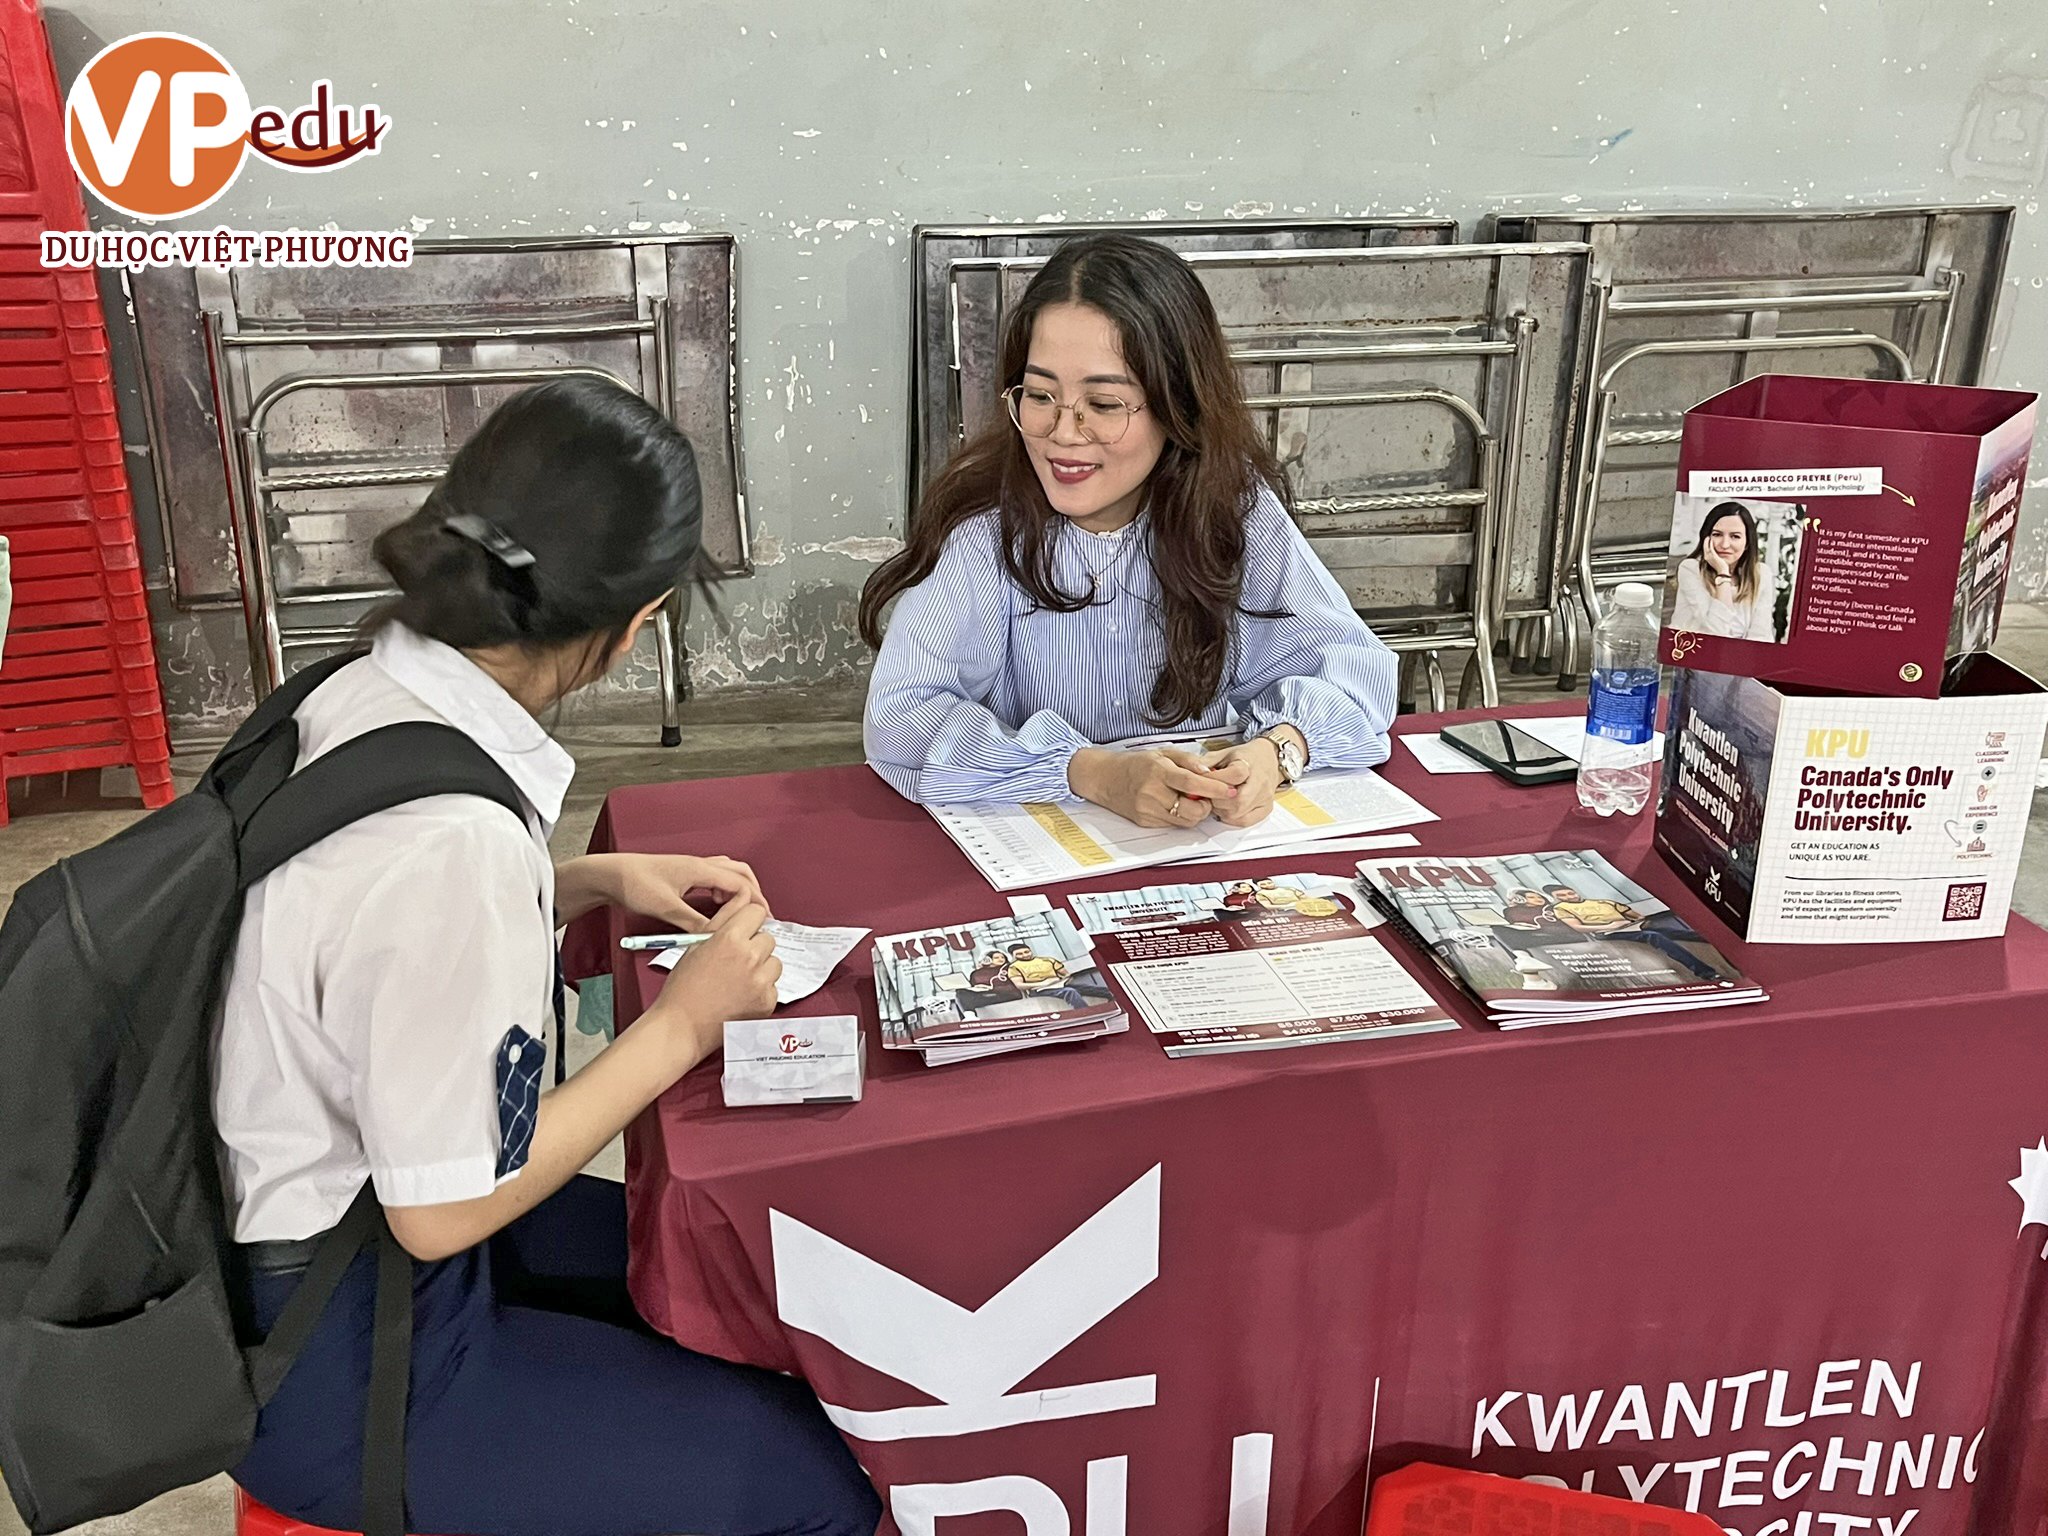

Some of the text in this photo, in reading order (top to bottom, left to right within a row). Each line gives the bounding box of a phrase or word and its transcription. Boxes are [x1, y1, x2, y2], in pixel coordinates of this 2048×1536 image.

[1711, 473, 1862, 483] MELISSA ARBOCCO FREYRE (Peru)
[1826, 529, 1833, 537] is
[1834, 531, 1847, 539] my
[1848, 530, 1863, 539] first
[1864, 533, 1900, 543] semester
[1901, 536, 1910, 544] at
[1911, 537, 1929, 545] KPU
[1837, 540, 1865, 549] mature
[1866, 541, 1918, 554] international
[1815, 556, 1900, 571] incredible experience.
[1853, 551, 1868, 559] and
[1882, 553, 1902, 562] been
[1812, 575, 1890, 589] exceptional services
[1831, 567, 1872, 578] impressed
[1873, 570, 1883, 580] by
[1884, 572, 1895, 580] all
[1896, 573, 1910, 581] the
[1813, 597, 1832, 606] have
[1833, 599, 1850, 609] only
[1875, 603, 1883, 611] in
[1884, 604, 1914, 614] Canada
[1823, 607, 1844, 616] three
[1844, 610, 1874, 619] months
[1875, 613, 1891, 621] and
[1892, 614, 1907, 623] feel
[1805, 624, 1828, 632] about
[1806, 615, 1829, 623] home
[1830, 617, 1851, 626] when
[1856, 620, 1877, 629] think
[1888, 624, 1903, 632] talk
[1688, 706, 1739, 767] Kwantlen
[1804, 728, 1870, 759] KPU
[1679, 731, 1742, 803] Polytechnic
[1800, 765, 1954, 789] Canada's Only
[1678, 765, 1735, 835] University
[1797, 788, 1927, 813] Polytechnic
[1794, 811, 1912, 835] University.
[1790, 842, 1806, 850] GET
[1808, 842, 1821, 850] AN
[1789, 854, 1821, 862] UNIQUE
[1376, 865, 1498, 889] KPU
[1704, 878, 1722, 902] KPU
[891, 930, 977, 961] KPU
[1552, 952, 1609, 960] Kwantlen
[1561, 957, 1631, 967] Polytechnic
[1571, 964, 1633, 973] University
[1471, 1359, 1922, 1459] KWANTLEN
